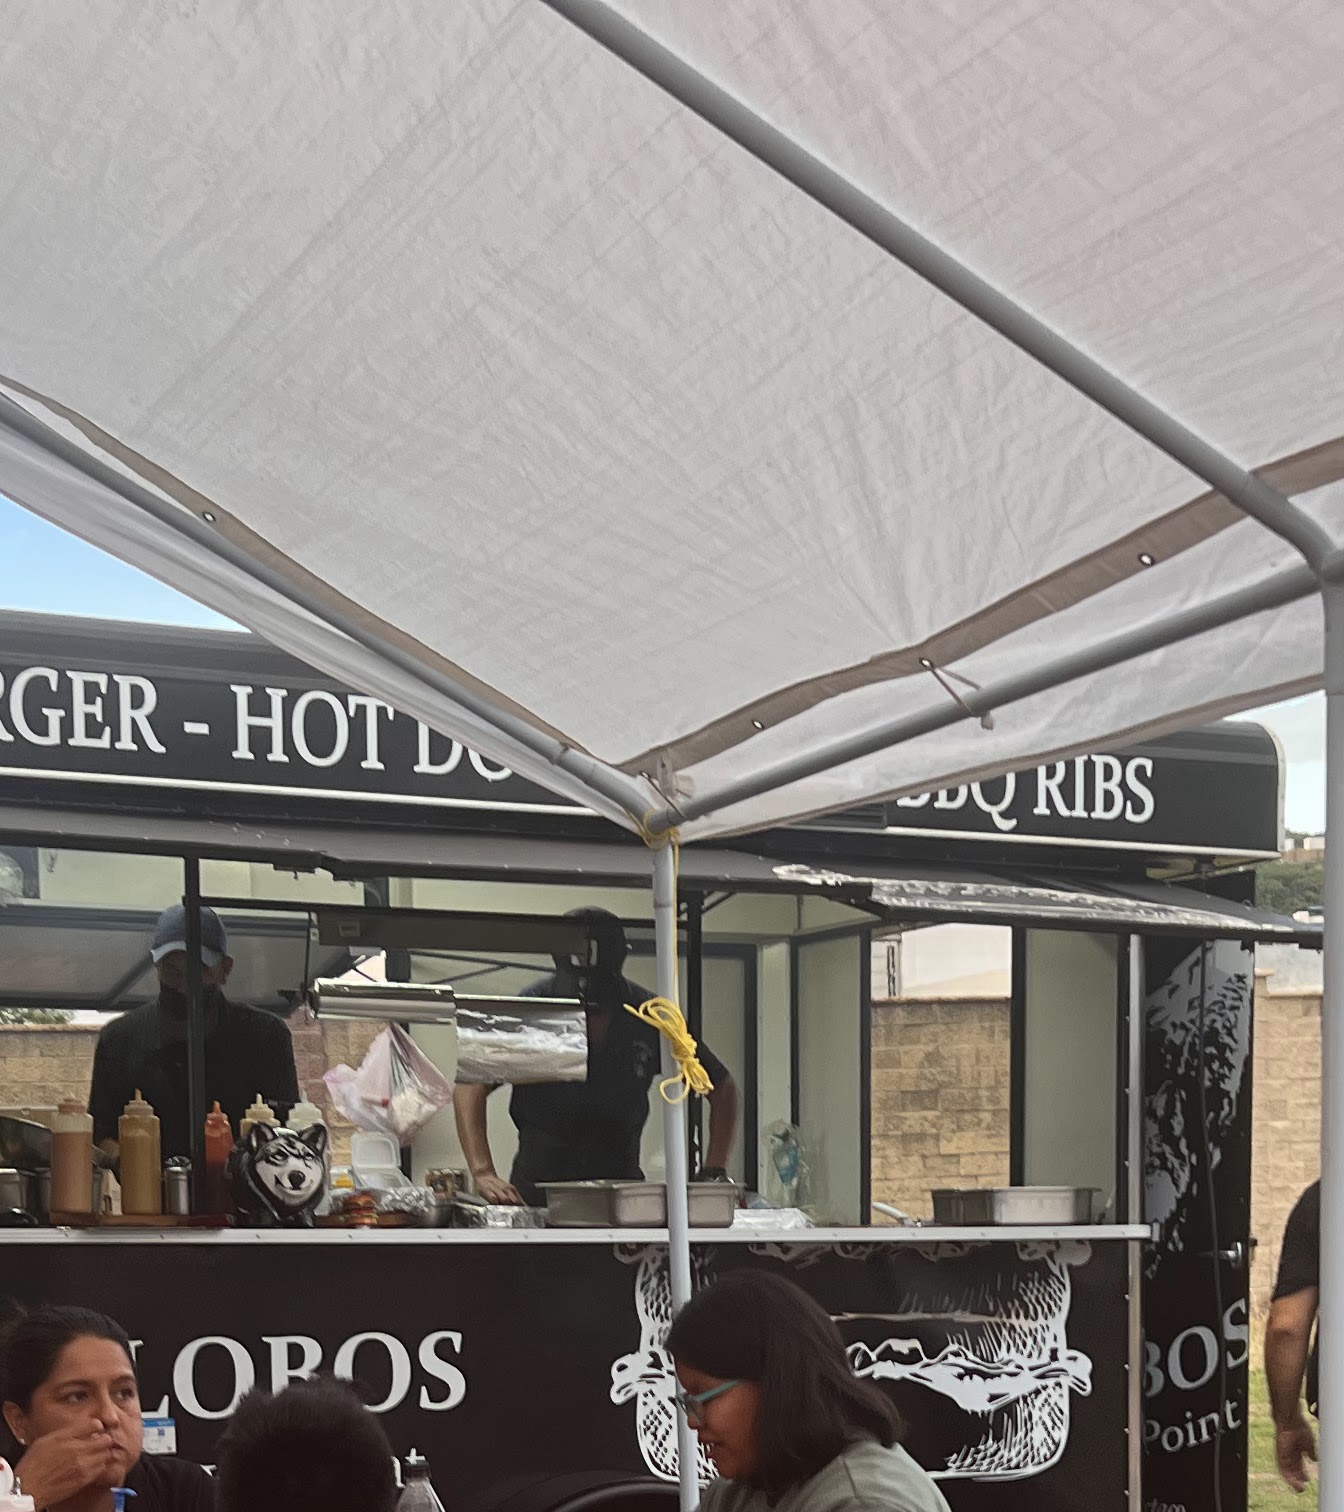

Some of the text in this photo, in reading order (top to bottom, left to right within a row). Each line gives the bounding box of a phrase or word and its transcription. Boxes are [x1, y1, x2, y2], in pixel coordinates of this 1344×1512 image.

[229, 684, 395, 772] HOT
[1032, 754, 1155, 824] RIBS
[129, 1330, 467, 1421] OBOS
